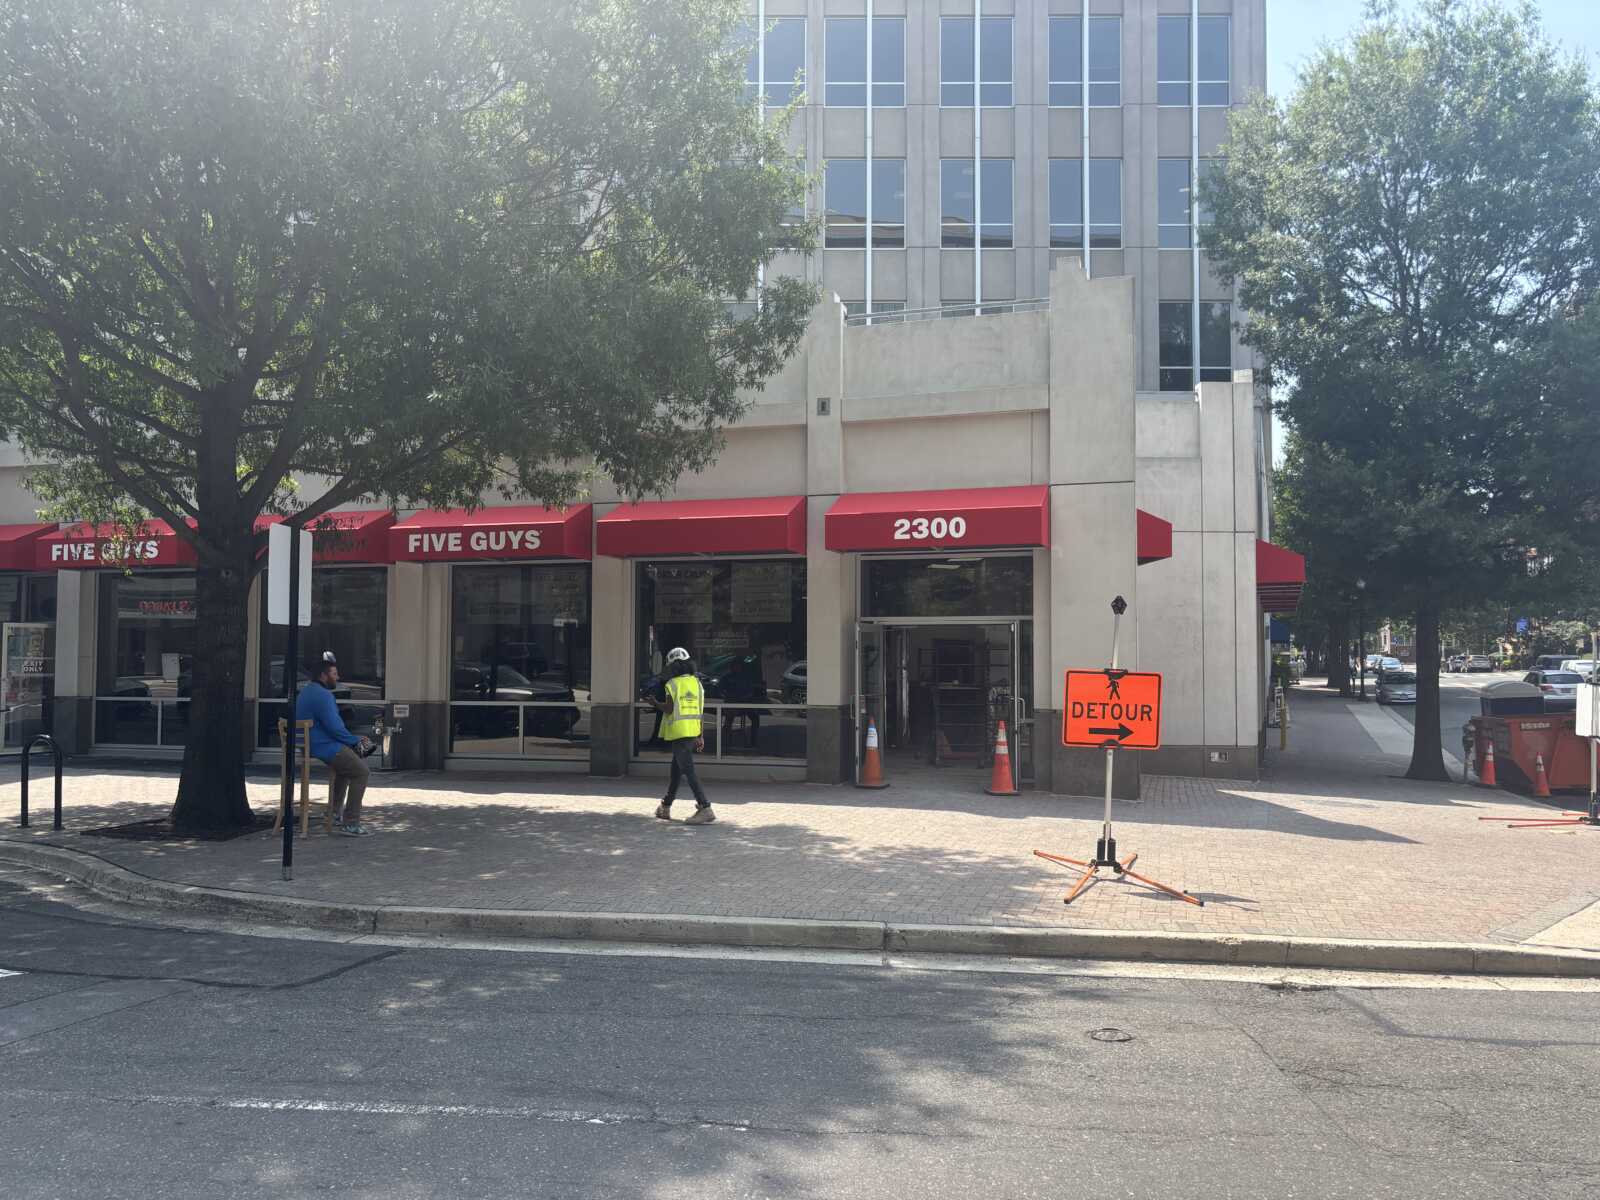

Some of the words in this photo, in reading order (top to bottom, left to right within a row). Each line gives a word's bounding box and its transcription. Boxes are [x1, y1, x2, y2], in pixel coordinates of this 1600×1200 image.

[894, 517, 966, 540] 2300
[51, 543, 96, 561] FIVE
[408, 532, 462, 553] FIVE
[470, 530, 540, 551] GUYS
[1072, 702, 1153, 721] DETOUR
